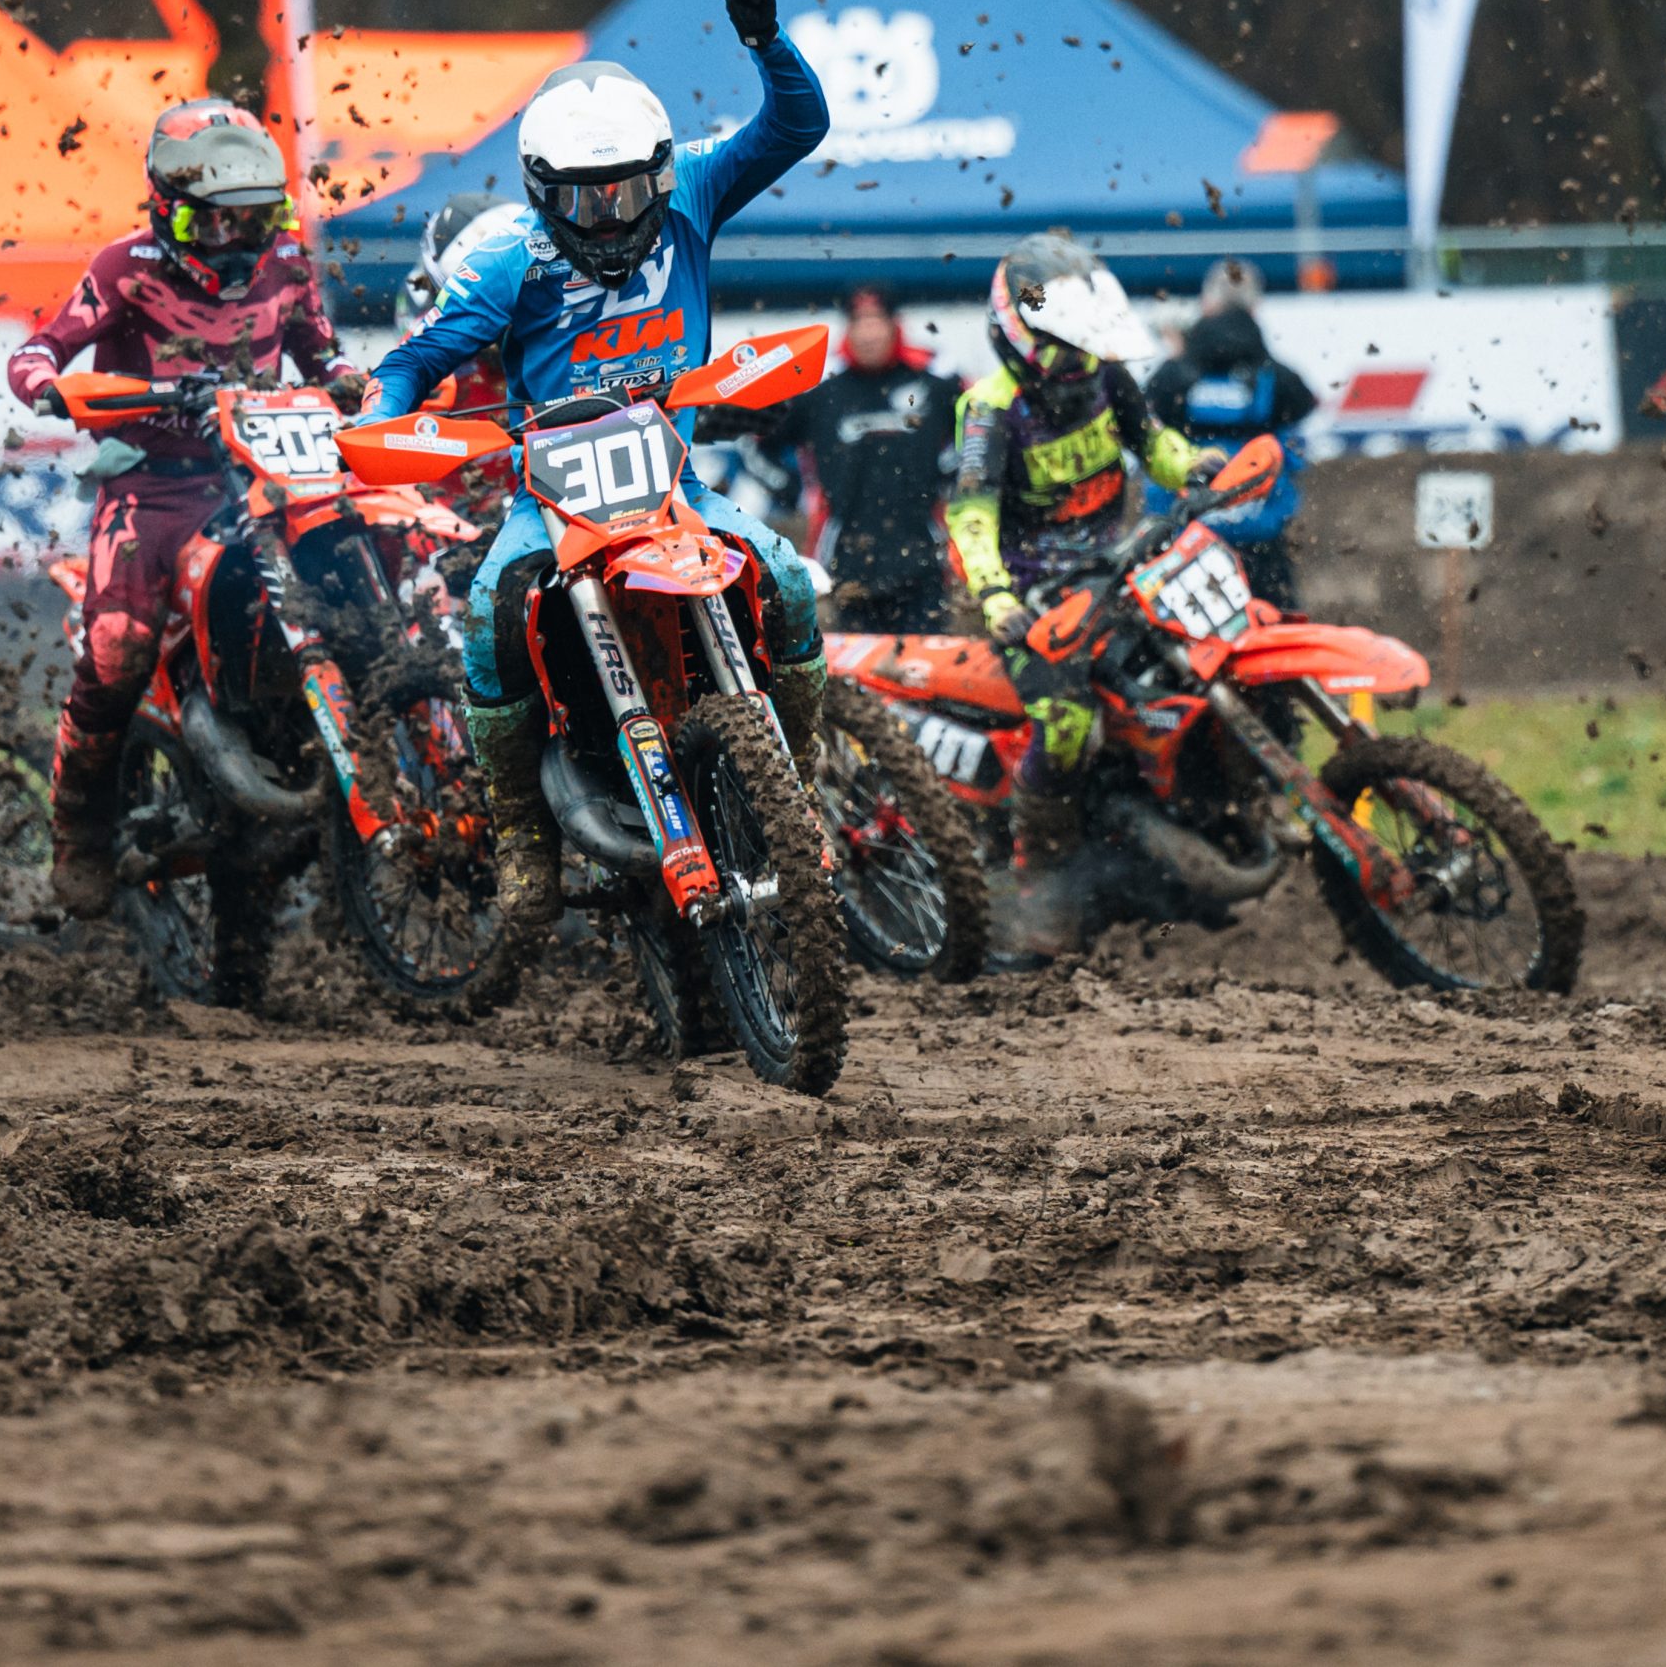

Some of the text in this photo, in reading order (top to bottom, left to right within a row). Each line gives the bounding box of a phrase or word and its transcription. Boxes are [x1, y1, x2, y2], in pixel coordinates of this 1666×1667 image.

[557, 244, 675, 330] FLY
[570, 308, 684, 364] KTM
[635, 356, 662, 369] Bihr
[545, 424, 672, 516] 301
[587, 612, 636, 697] HRS
